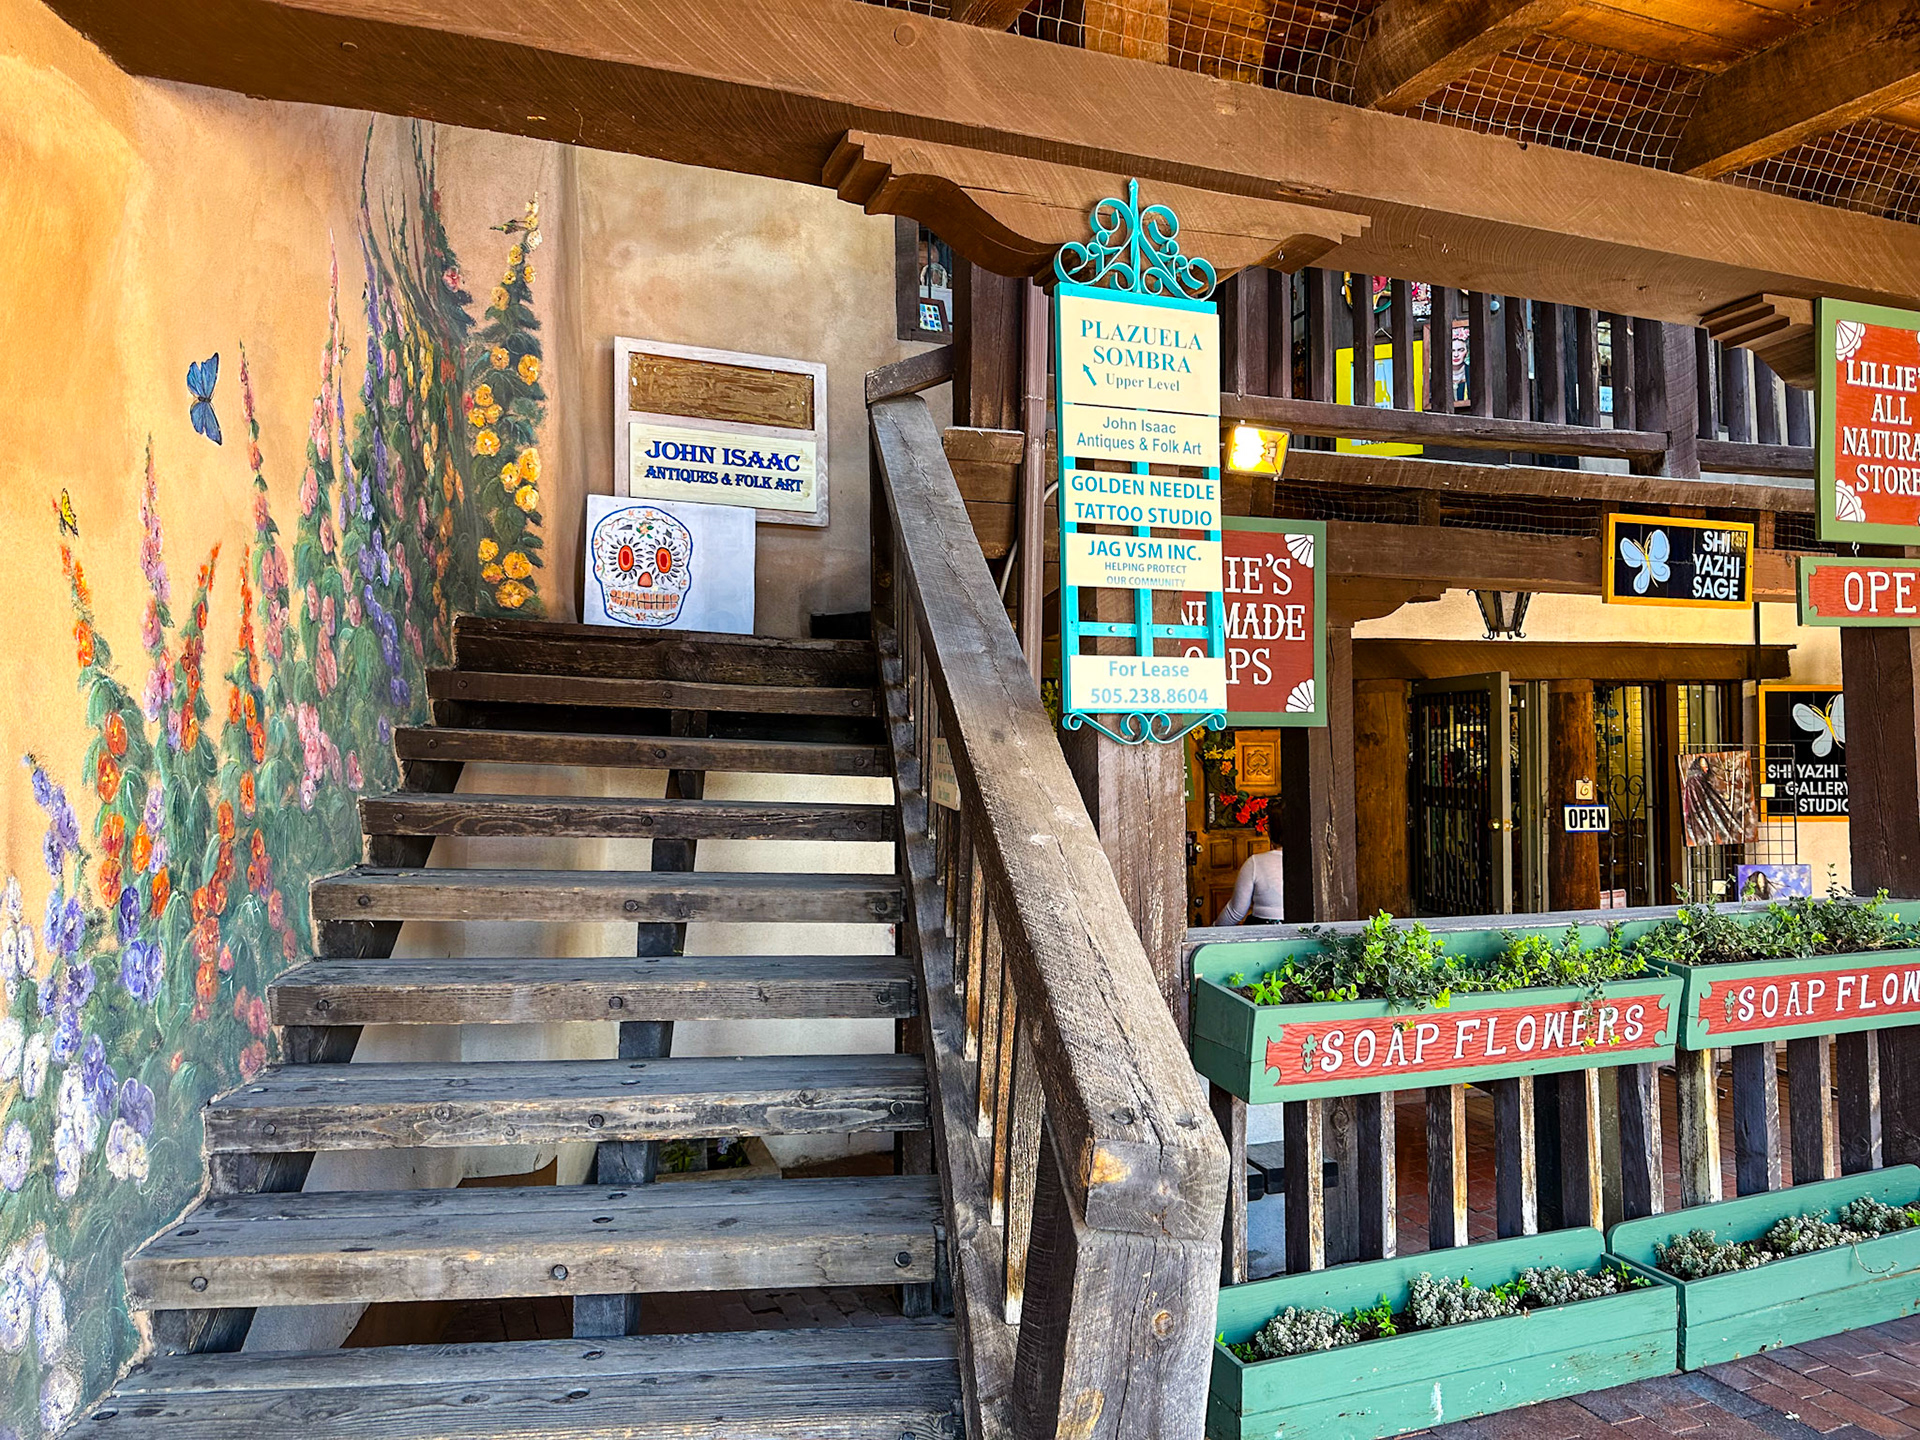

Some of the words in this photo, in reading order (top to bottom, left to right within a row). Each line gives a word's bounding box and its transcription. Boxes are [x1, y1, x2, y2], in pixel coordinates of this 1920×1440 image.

[1080, 318, 1203, 351] PLAZUELA
[1093, 345, 1192, 374] SOMBRA
[1106, 373, 1144, 390] Upper
[1148, 377, 1180, 392] Level
[1870, 393, 1912, 425] ALL
[1102, 416, 1137, 431] John
[1141, 419, 1177, 434] Isaac
[645, 440, 716, 464] JOHN
[722, 447, 800, 472] ISAAC
[1076, 432, 1135, 452] Antiques
[1139, 437, 1149, 451] &
[1152, 438, 1179, 454] Folk
[1182, 441, 1202, 456] Art
[644, 465, 718, 484] ANTIQUES
[721, 473, 733, 486] &
[735, 474, 772, 490] FOLK
[774, 478, 804, 493] ART
[1071, 475, 1145, 496] GOLDEN
[1150, 481, 1215, 501] NEEDLE
[1856, 464, 1920, 496] STORE
[1075, 502, 1143, 523] TATTOO
[1148, 507, 1213, 526] STUDIO
[1088, 540, 1121, 557] JAG
[1125, 542, 1163, 559] VSM
[1168, 544, 1202, 561] INC.
[1702, 530, 1731, 553] SHI
[1105, 562, 1145, 573] HELPING
[1147, 564, 1188, 574] PROTECT
[1692, 553, 1740, 578] YAZHI
[1106, 575, 1126, 585] OUR
[1128, 577, 1186, 588] COMMUNITY
[1692, 576, 1739, 600] SAGE
[1844, 571, 1917, 613] OPE
[1109, 660, 1137, 677] For
[1141, 661, 1190, 678] Lease
[1090, 688, 1209, 705] 505.238.8604
[1767, 764, 1792, 779] SHI
[1796, 764, 1839, 779] YAZHI
[1568, 808, 1606, 829] OPEN
[1737, 979, 1826, 1022] SOAP
[1319, 1022, 1440, 1073] SOAP
[1452, 1003, 1645, 1060] FLOWERS
